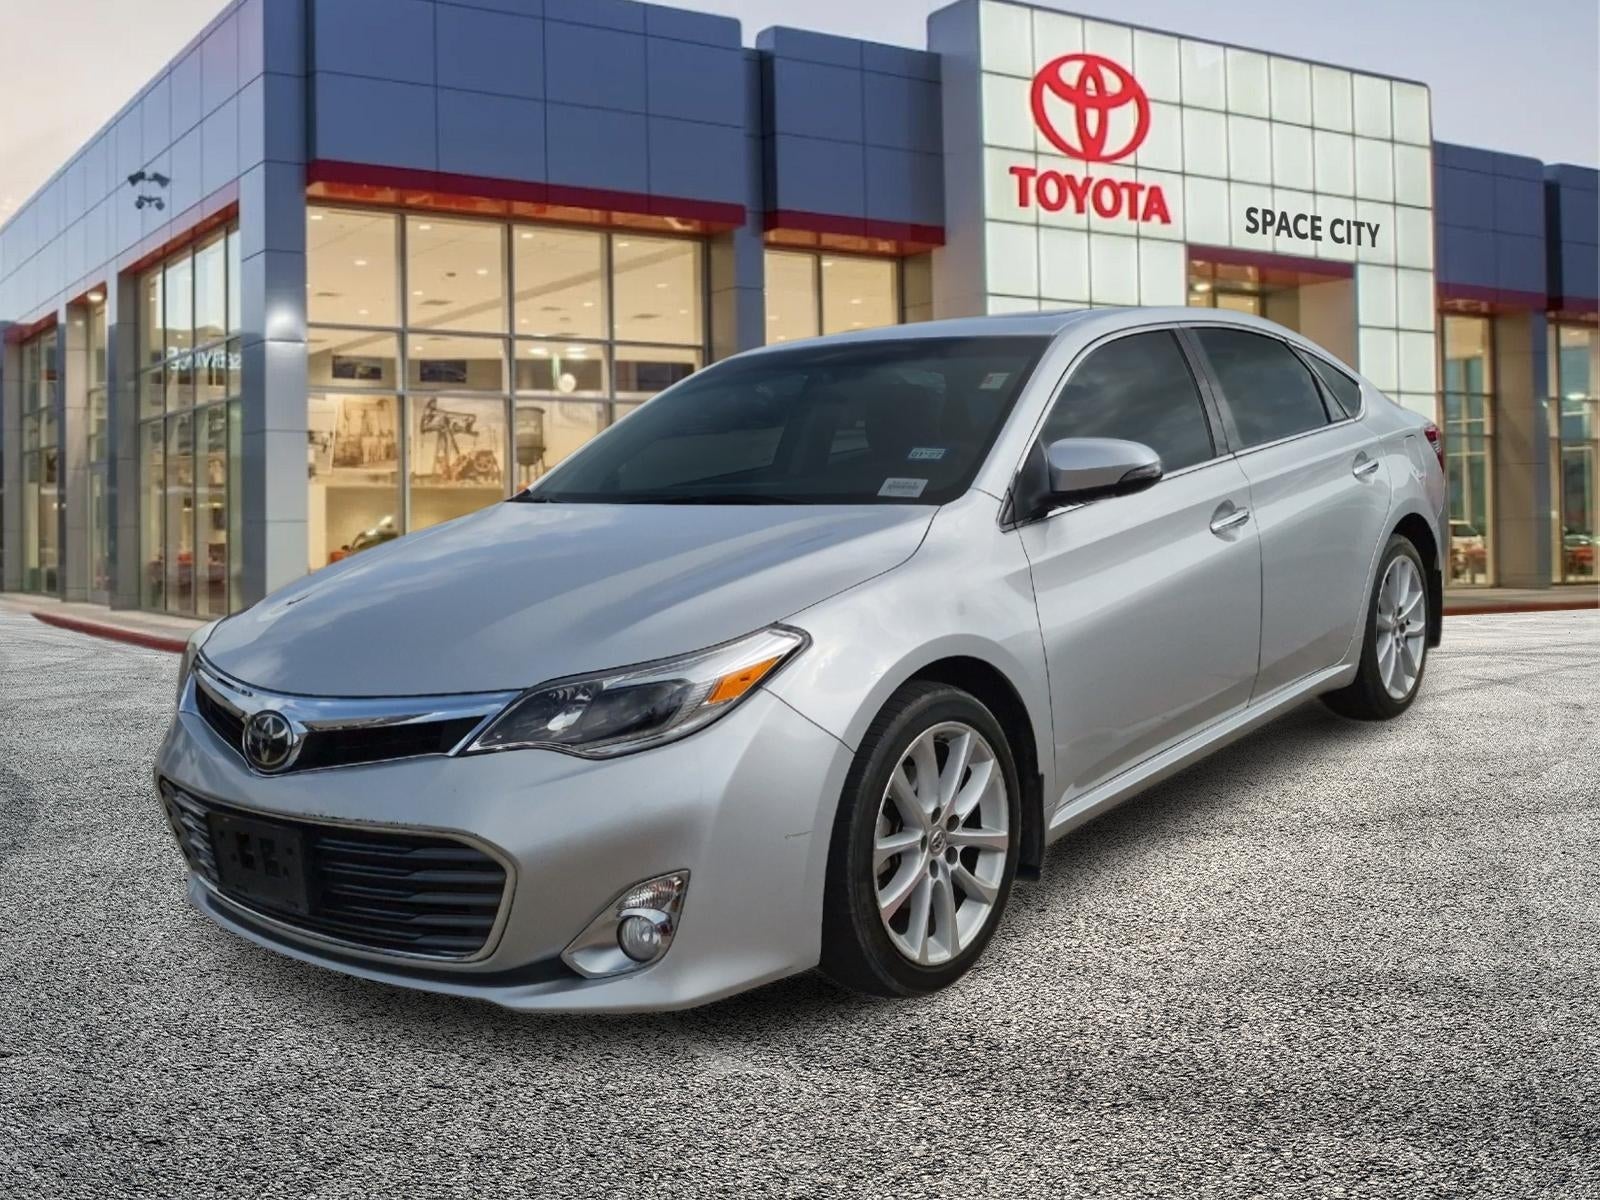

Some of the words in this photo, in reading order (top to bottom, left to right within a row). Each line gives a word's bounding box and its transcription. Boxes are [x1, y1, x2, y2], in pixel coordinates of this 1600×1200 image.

[1009, 166, 1171, 224] TOYOTA
[1245, 206, 1322, 242] SPACE
[1329, 218, 1380, 248] CITY
